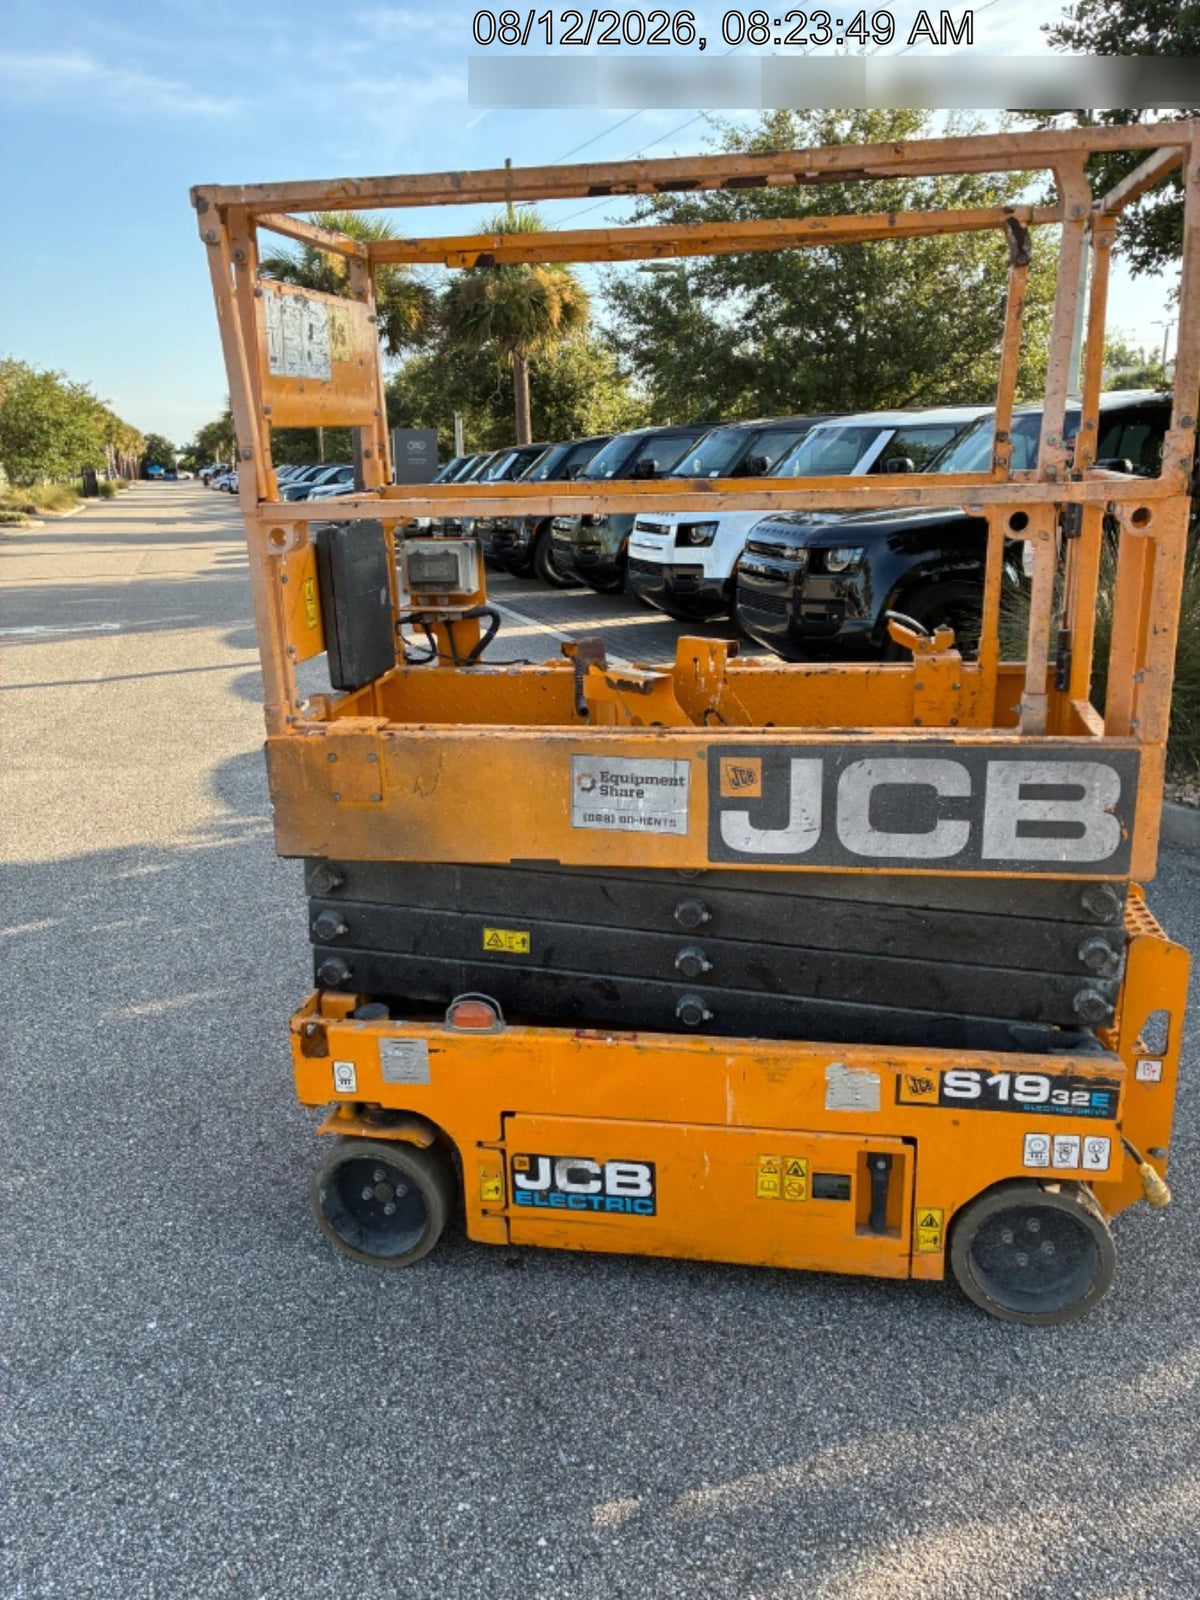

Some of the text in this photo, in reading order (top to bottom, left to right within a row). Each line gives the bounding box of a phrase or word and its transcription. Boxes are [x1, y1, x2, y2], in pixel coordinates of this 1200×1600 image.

[599, 771, 685, 788] Equipment
[599, 785, 645, 799] Share
[720, 757, 1122, 862] JCB
[514, 1156, 653, 1198] JCB
[514, 1190, 654, 1215] ELECTRIC
